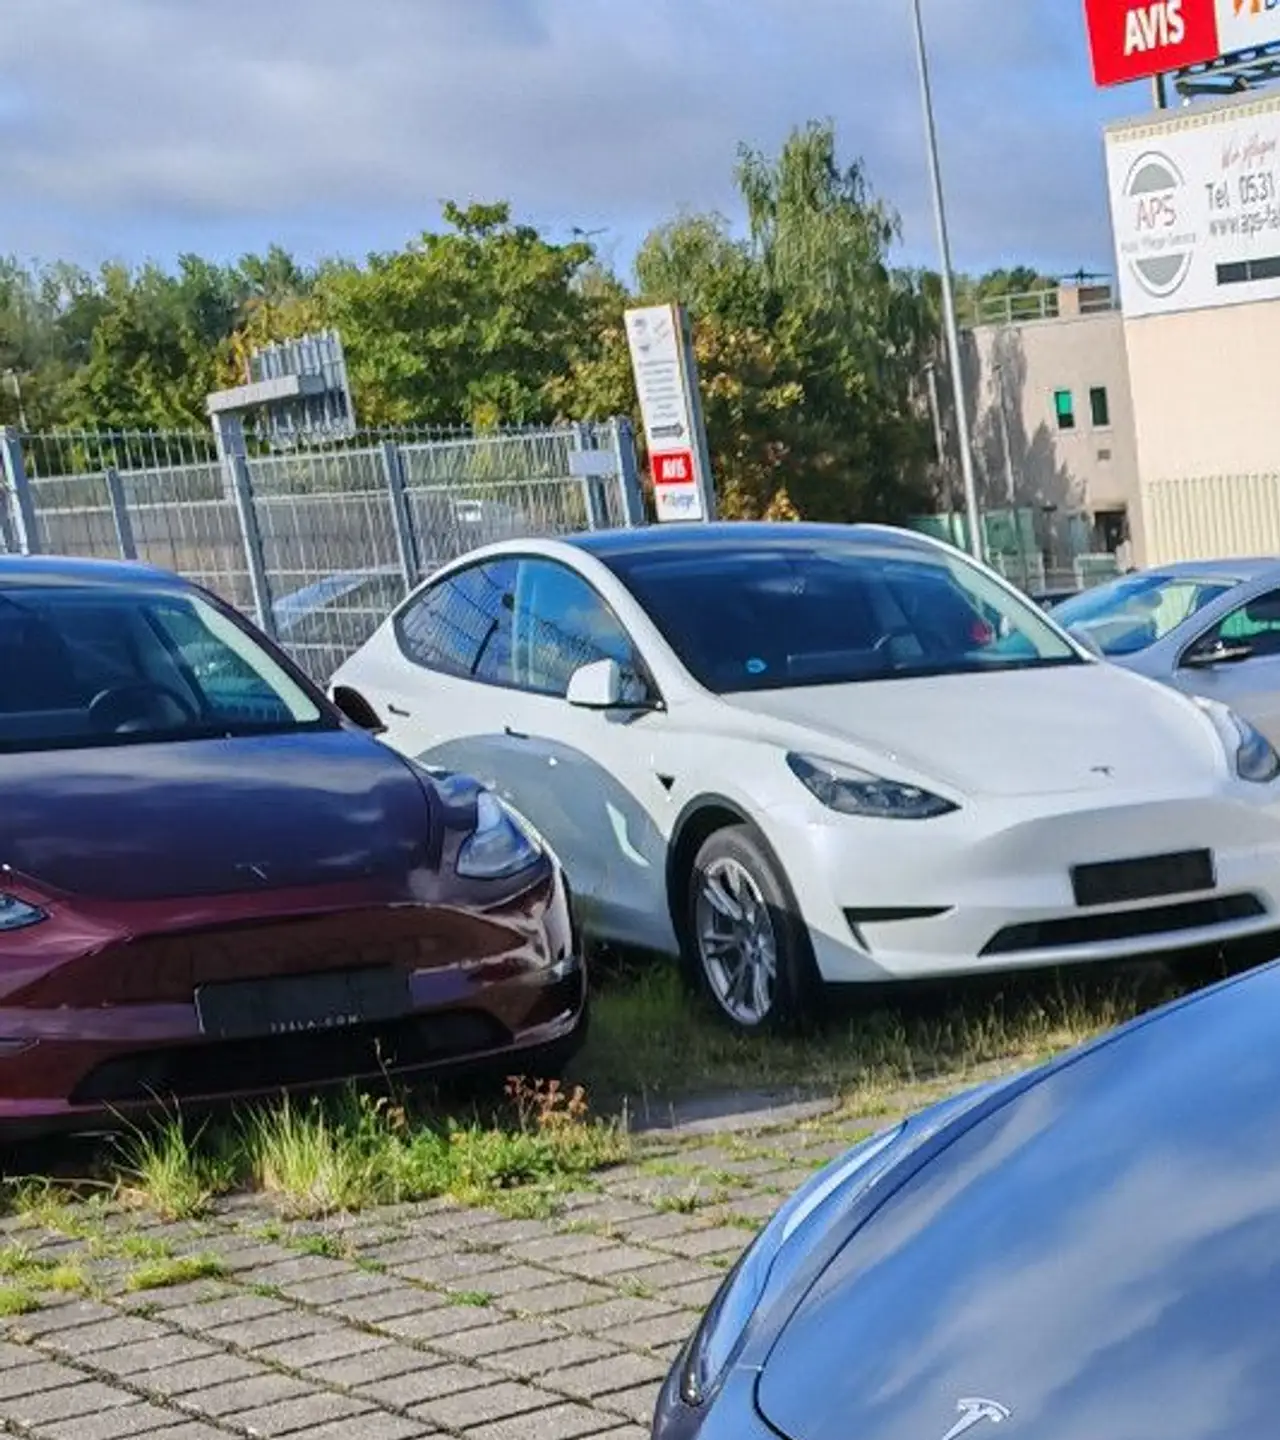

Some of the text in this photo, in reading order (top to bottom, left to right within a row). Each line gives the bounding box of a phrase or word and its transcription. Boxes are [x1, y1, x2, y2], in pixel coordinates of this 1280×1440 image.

[1124, 3, 1184, 56] AVIS
[1238, 171, 1276, 205] 0531
[1134, 193, 1178, 231] APS
